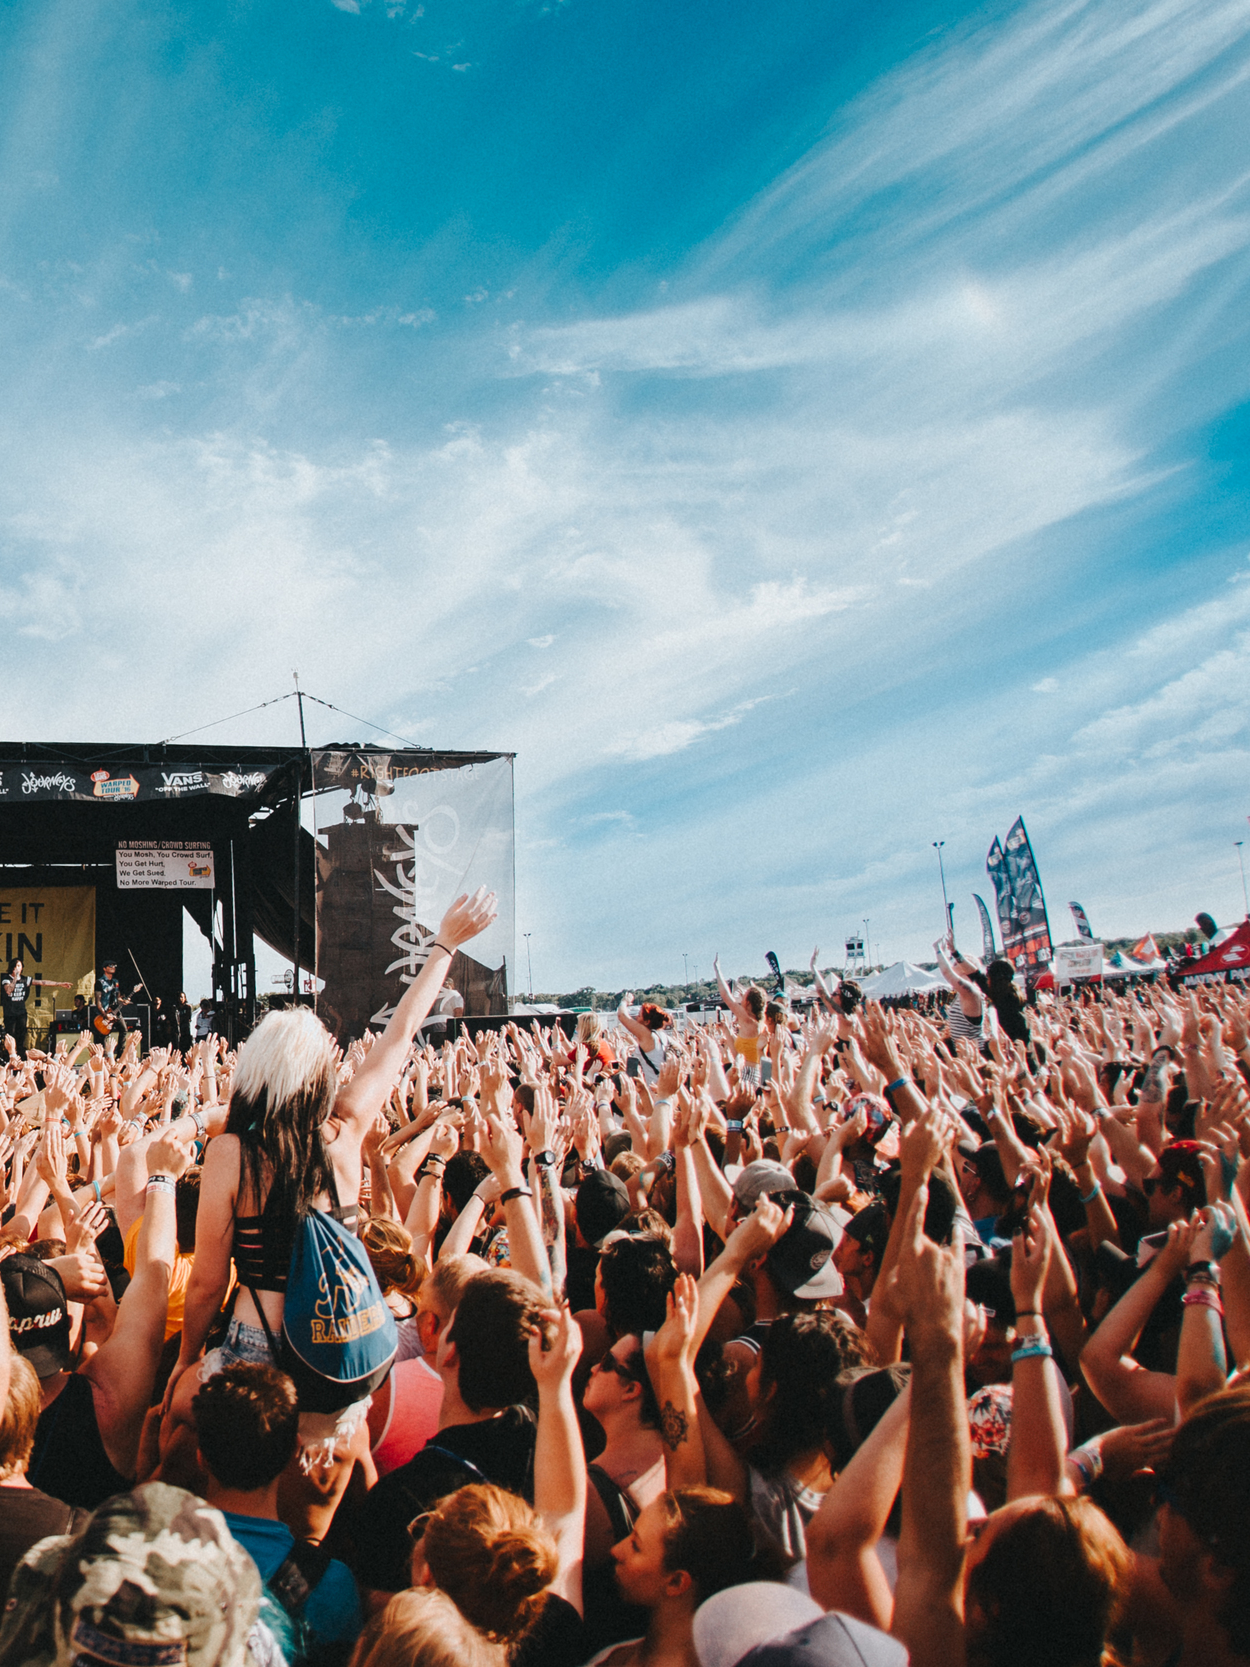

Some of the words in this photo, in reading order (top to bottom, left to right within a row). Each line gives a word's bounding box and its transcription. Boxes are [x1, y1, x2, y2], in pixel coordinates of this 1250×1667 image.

[21, 771, 76, 794] JOURNEYS
[160, 771, 203, 787] VANS
[100, 780, 132, 789] WARPED
[189, 782, 211, 790] WALL"
[100, 786, 121, 795] TOUR
[118, 840, 128, 849] NO
[184, 841, 211, 850] SURFING
[148, 860, 165, 868] Hurt,
[151, 879, 177, 888] Warped
[21, 902, 45, 924] IT
